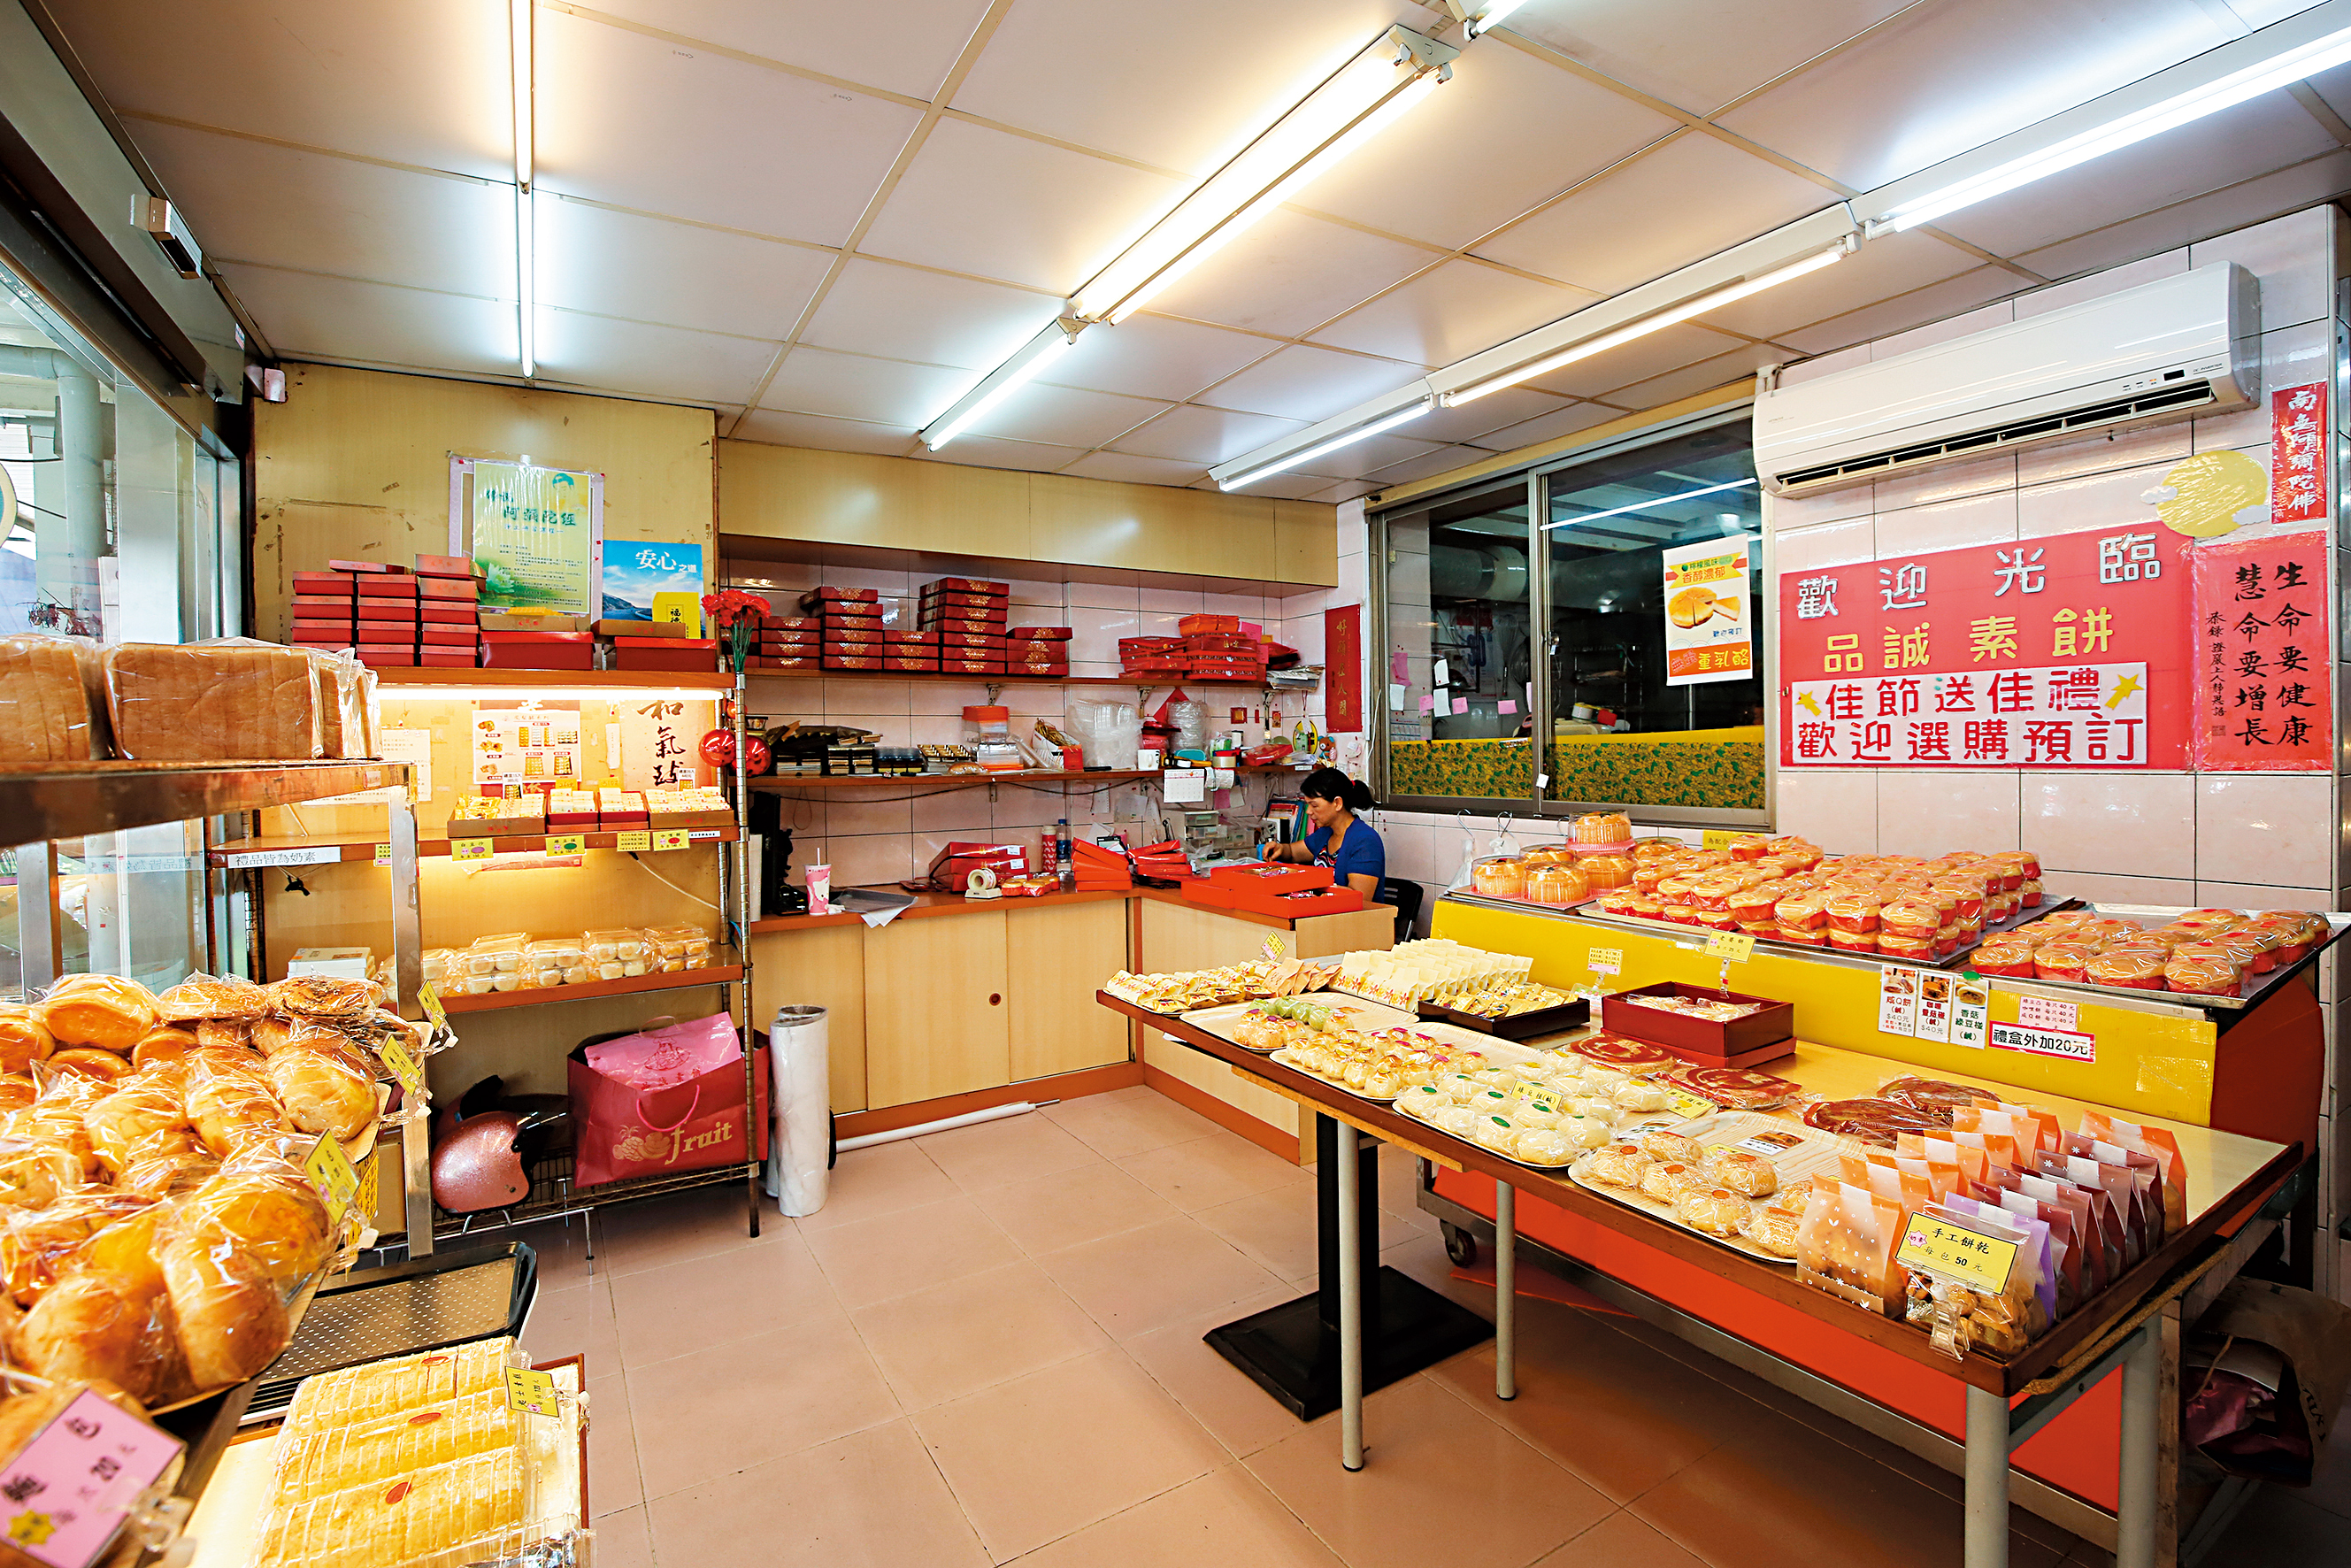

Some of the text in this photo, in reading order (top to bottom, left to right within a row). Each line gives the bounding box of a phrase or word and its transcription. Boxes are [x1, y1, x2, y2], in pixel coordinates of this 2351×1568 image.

[503, 505, 577, 527] 阿彌陀經
[634, 549, 677, 571] 安心
[1682, 565, 1726, 583] 香醇濃郁
[1796, 532, 2163, 619] 歡迎光臨
[1823, 606, 2114, 673] 品誠素餅
[2232, 562, 2276, 748] 慧命要增長
[2270, 560, 2316, 748] 生命要健康
[1825, 668, 2101, 722] 佳節送佳禮
[1797, 712, 2145, 764] 歡迎選購預訂
[234, 851, 317, 867] 禮品皆為奶素
[1993, 1029, 2089, 1056] 禮盒外加20元
[1932, 1226, 1991, 1255] 手工餅乾
